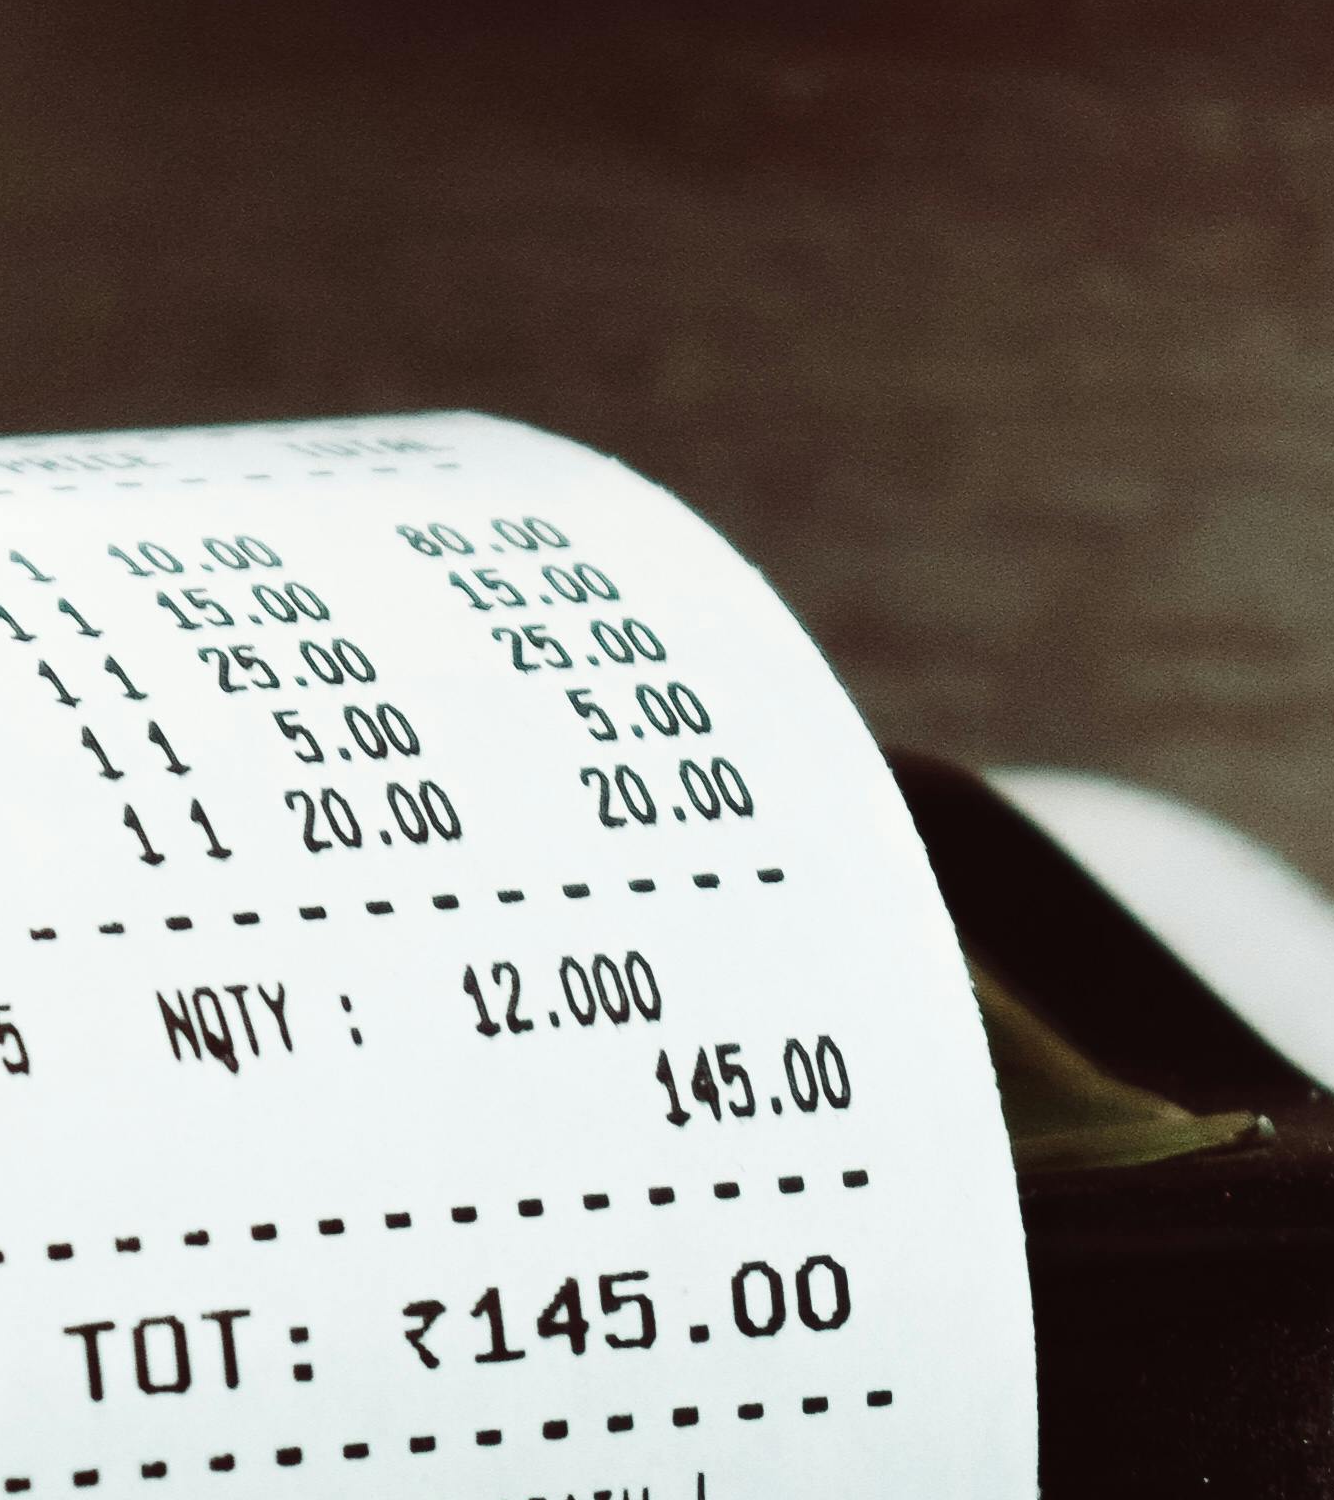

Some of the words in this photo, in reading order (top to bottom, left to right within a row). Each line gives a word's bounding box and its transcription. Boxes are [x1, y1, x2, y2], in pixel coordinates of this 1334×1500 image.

[10, 551, 53, 583] 1
[108, 537, 283, 578] 10.00
[397, 517, 571, 558] 80.00
[57, 598, 103, 639] 1
[156, 582, 331, 631] 15.00
[448, 563, 621, 612] 15.00
[37, 659, 82, 709] 1
[103, 654, 149, 702] 1
[197, 638, 377, 695] 25.00
[491, 618, 668, 675] 25.00
[80, 725, 126, 782] 1
[147, 720, 192, 777] 1
[271, 702, 422, 765] 5.00
[565, 681, 713, 743] 5.00
[122, 803, 166, 868] 1
[189, 797, 233, 862] 1
[283, 779, 464, 855] 20.00
[579, 756, 755, 830] 20.00
[156, 982, 294, 1075] NQTY
[462, 950, 662, 1039] 12.000
[655, 1034, 852, 1128] 145.00
[62, 1308, 315, 1403] TOT:
[401, 1254, 852, 1371] ₹145.00
